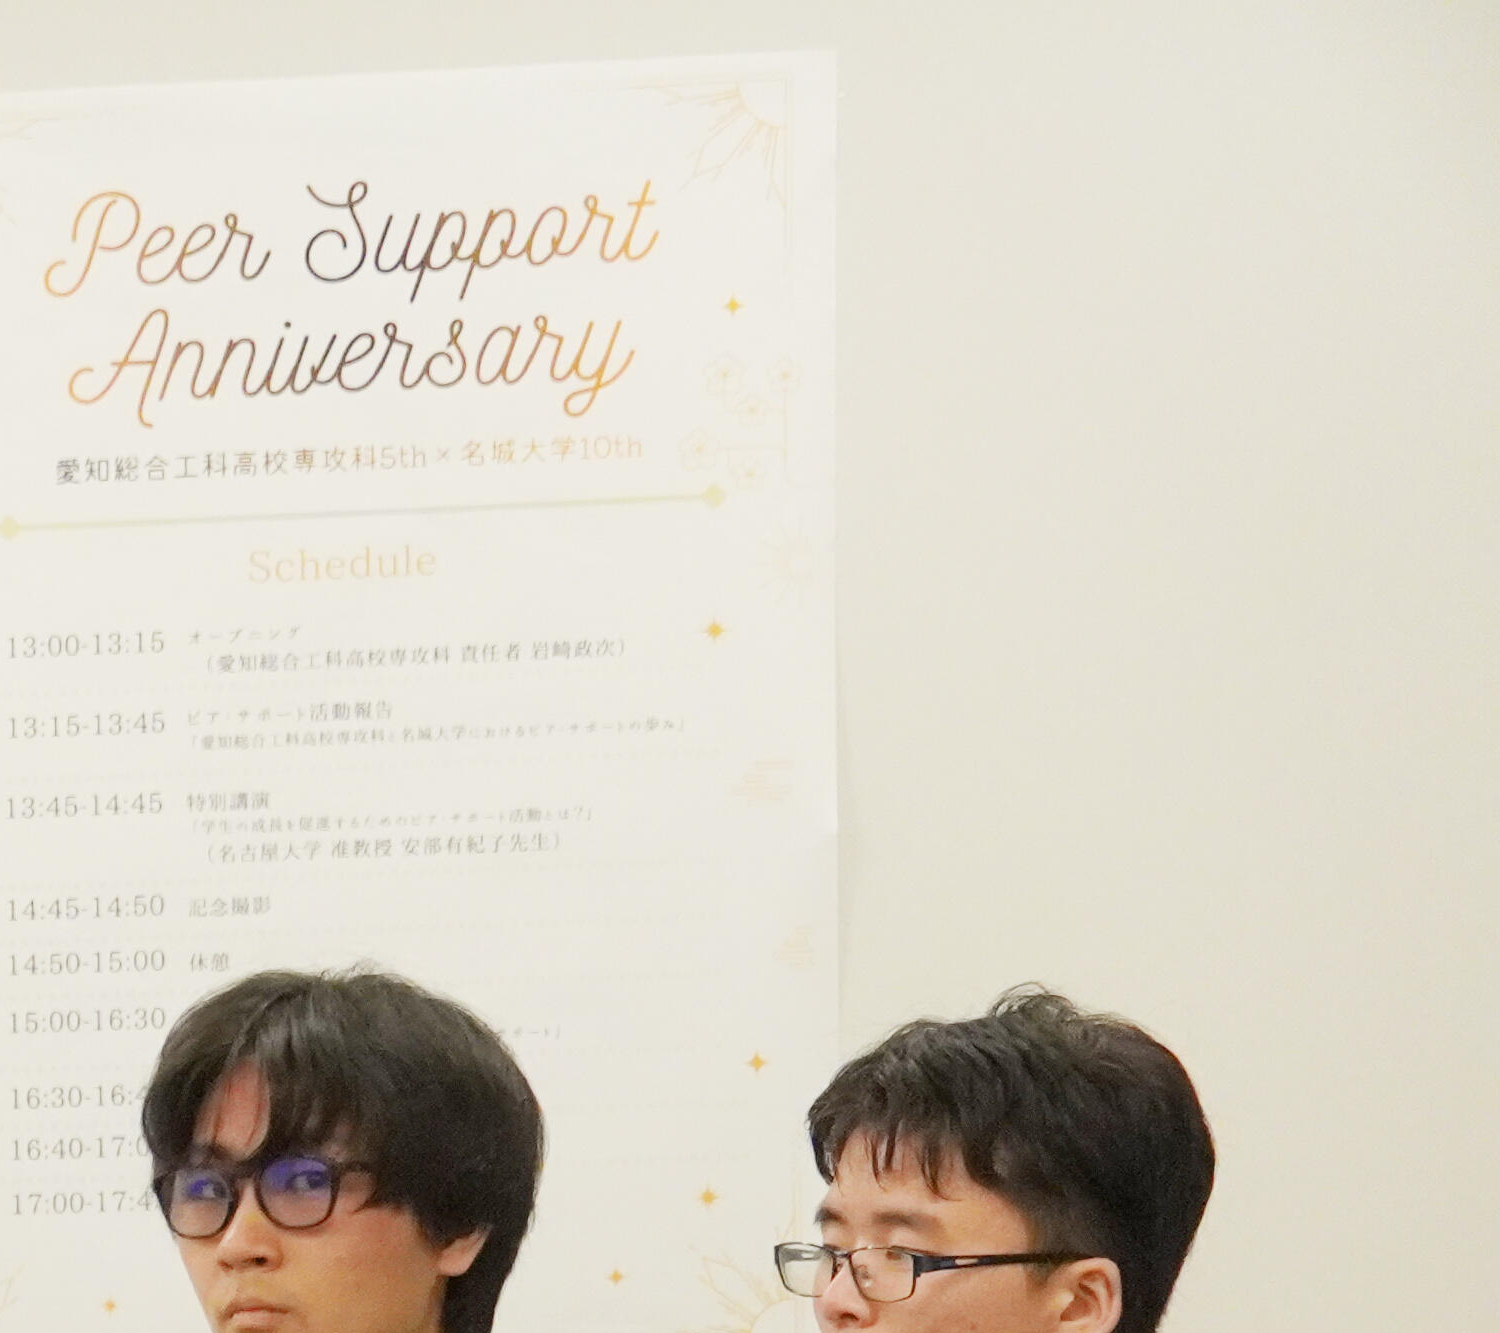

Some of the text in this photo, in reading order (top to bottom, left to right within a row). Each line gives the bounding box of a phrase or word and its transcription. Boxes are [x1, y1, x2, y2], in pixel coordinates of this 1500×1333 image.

[44, 180, 660, 302] Peer Support
[68, 308, 635, 428] Anniversary
[248, 544, 438, 586] Schedule
[7, 630, 165, 660] 13:00-13:15
[7, 708, 166, 740] 13:15-13:45
[6, 790, 164, 820] 13:45-14:45
[7, 895, 165, 922] 14:45-14:50
[8, 949, 166, 976] 14:50-15:00
[10, 1007, 166, 1034] 15:00-16:30
